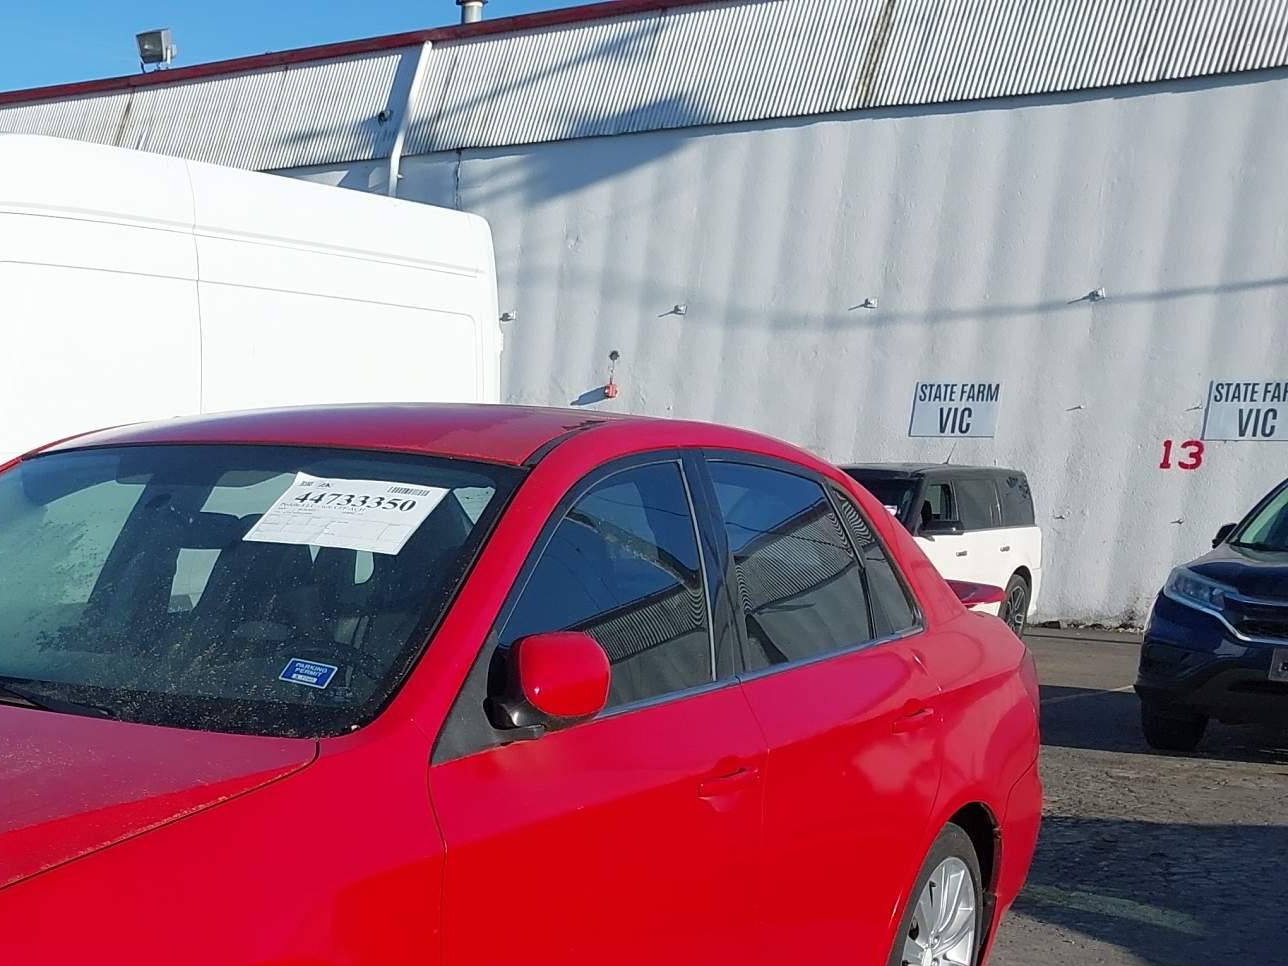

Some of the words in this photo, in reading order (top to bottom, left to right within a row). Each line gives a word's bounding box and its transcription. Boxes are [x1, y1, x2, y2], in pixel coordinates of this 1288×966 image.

[919, 383, 957, 402] STATE
[960, 383, 1000, 402] FARM
[1214, 383, 1260, 402] STATE
[939, 407, 972, 434] VIC
[1238, 407, 1278, 437] VIC
[1159, 439, 1204, 469] 13
[295, 491, 417, 512] 44733350
[294, 667, 323, 677] PERMIT
[295, 662, 328, 674] PARKING
